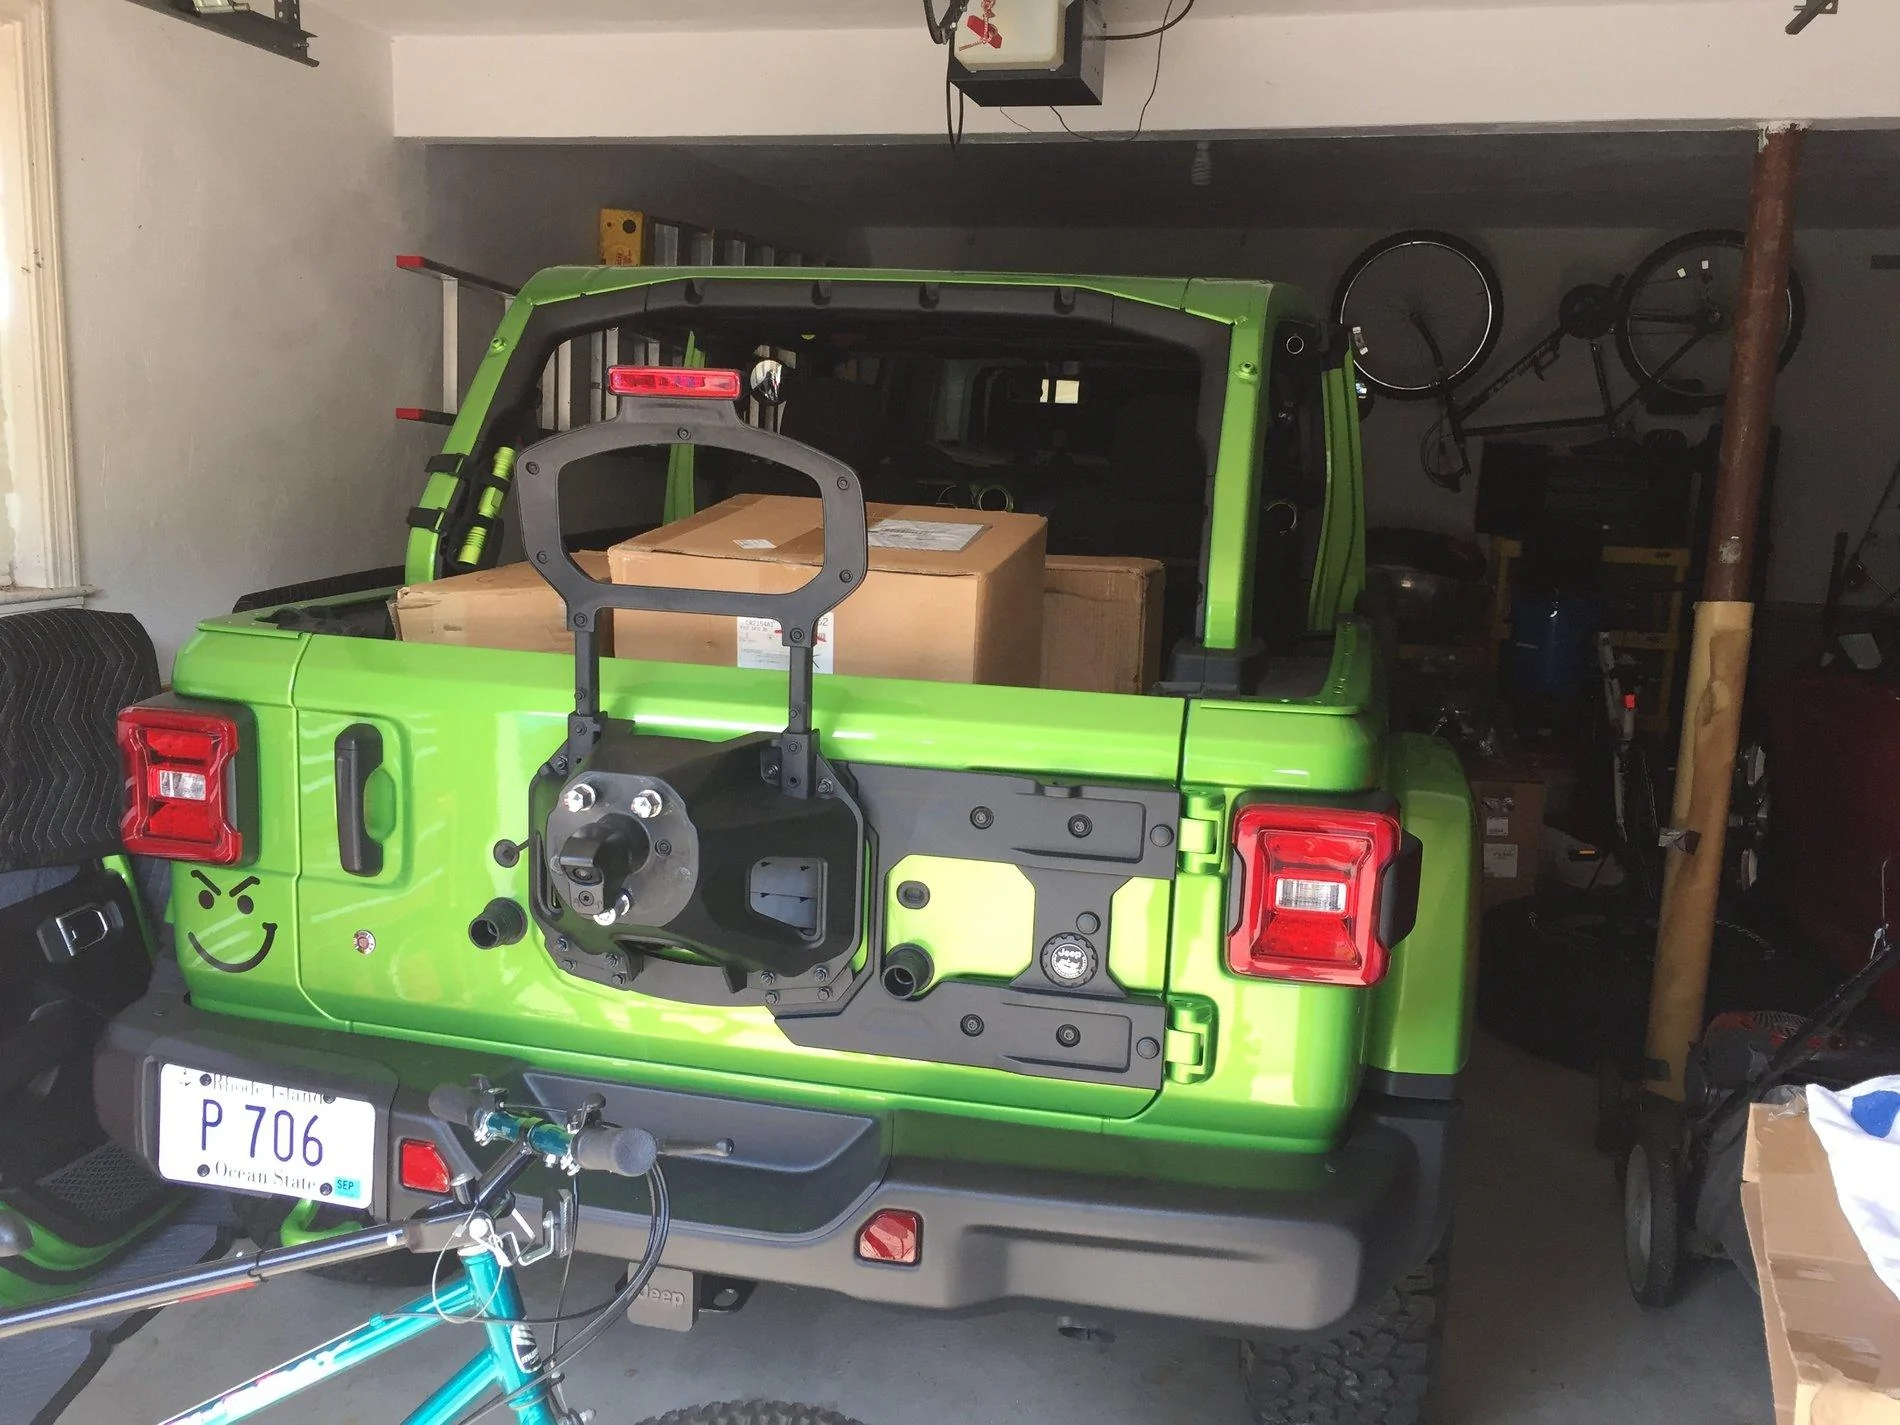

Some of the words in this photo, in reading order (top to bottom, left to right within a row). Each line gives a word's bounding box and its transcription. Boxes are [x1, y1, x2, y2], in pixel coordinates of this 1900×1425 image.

[1058, 948, 1082, 959] Jeep
[202, 1099, 223, 1151] P
[245, 1104, 323, 1167] 706
[215, 1159, 268, 1185] Ocean
[273, 1170, 317, 1191] State
[337, 1179, 354, 1191] SEP
